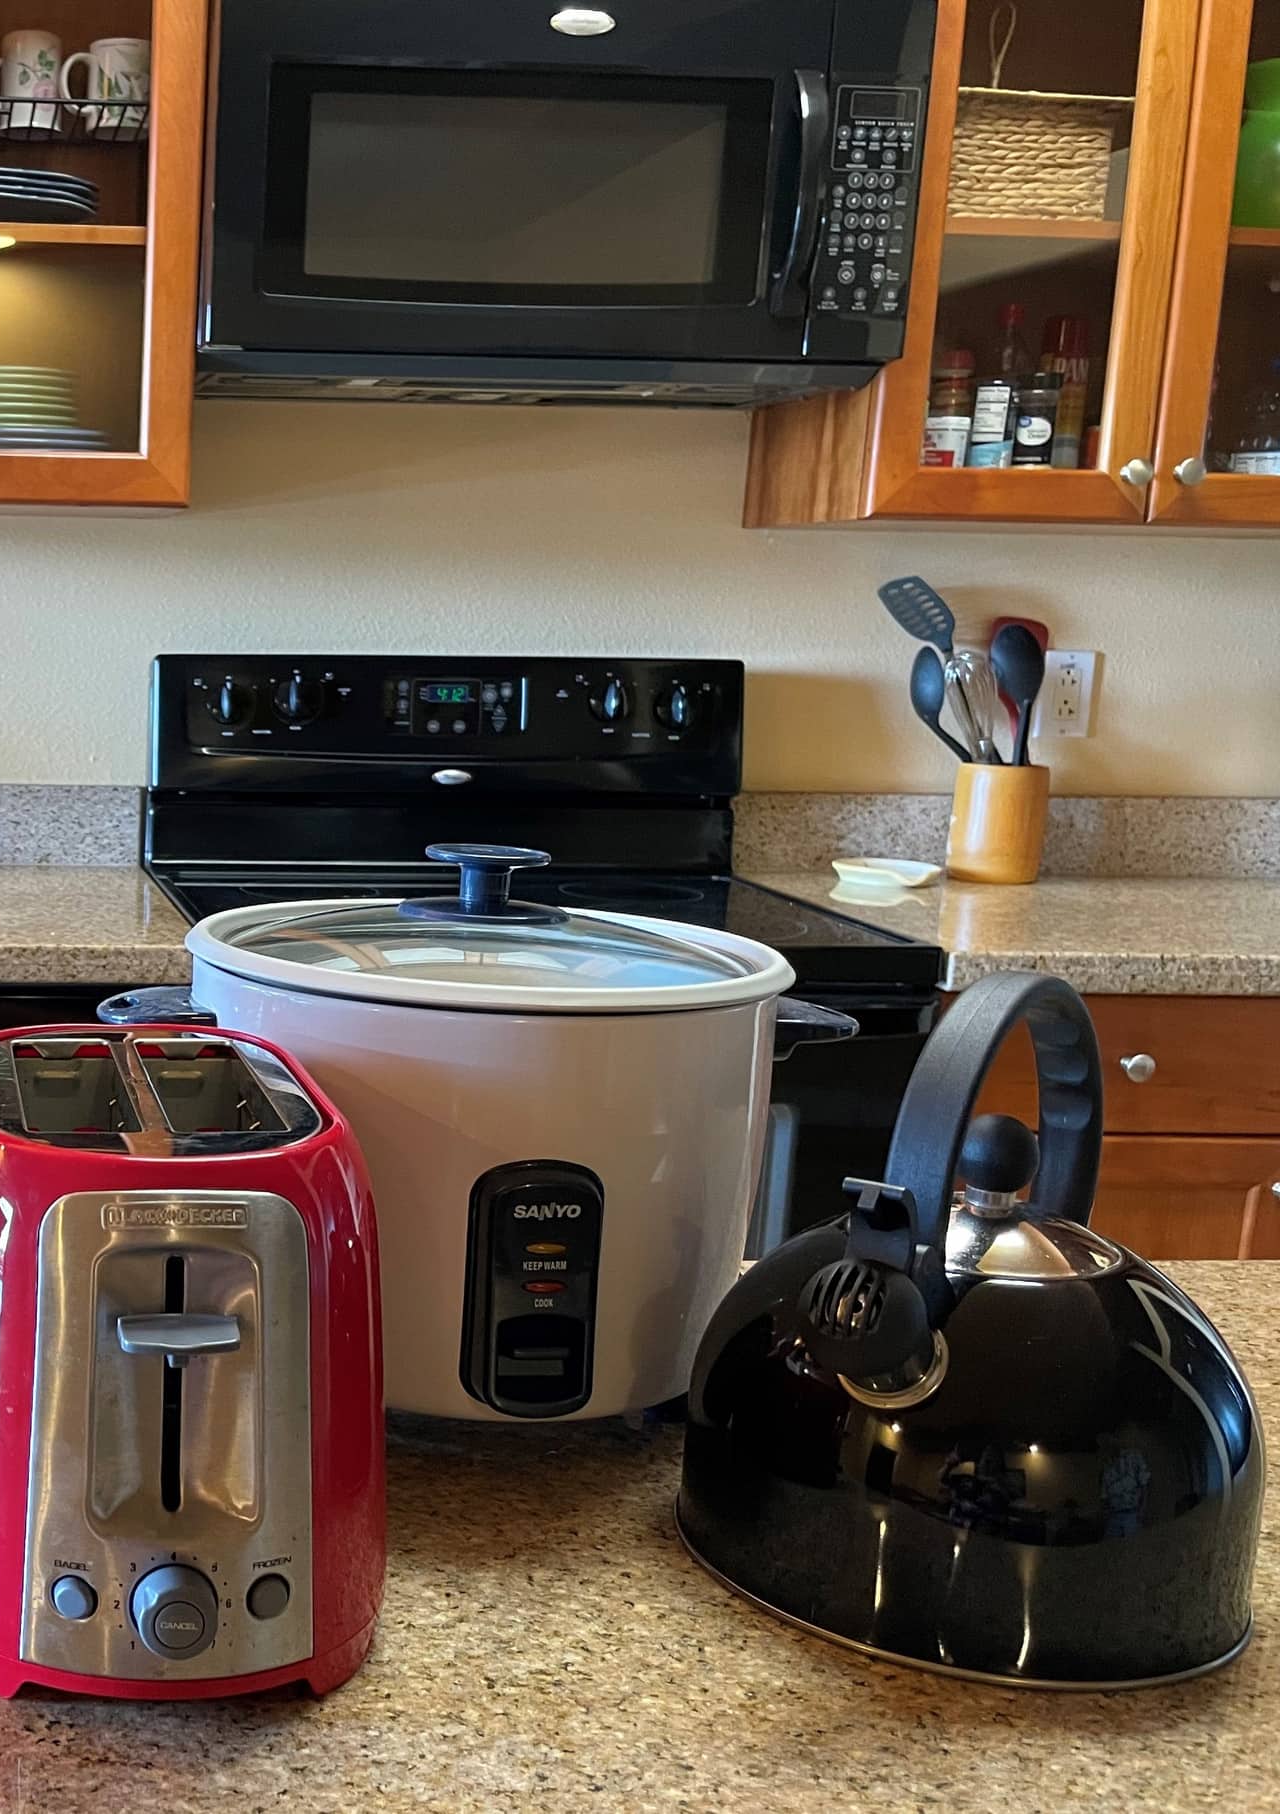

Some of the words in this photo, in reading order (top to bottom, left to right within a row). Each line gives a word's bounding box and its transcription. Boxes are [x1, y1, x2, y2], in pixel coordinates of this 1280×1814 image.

[513, 1202, 582, 1221] SANYO
[523, 1261, 543, 1271] KEEP
[544, 1260, 567, 1271] WARM
[534, 1298, 553, 1308] COOK
[170, 1552, 176, 1561] 4
[54, 1559, 89, 1572] BAGEL
[130, 1563, 136, 1572] 3
[211, 1562, 217, 1572] 5
[252, 1555, 292, 1570] FROZEN
[113, 1600, 120, 1610] 2
[225, 1599, 232, 1609] 6
[159, 1621, 199, 1631] CANCEL
[130, 1640, 135, 1650] 1
